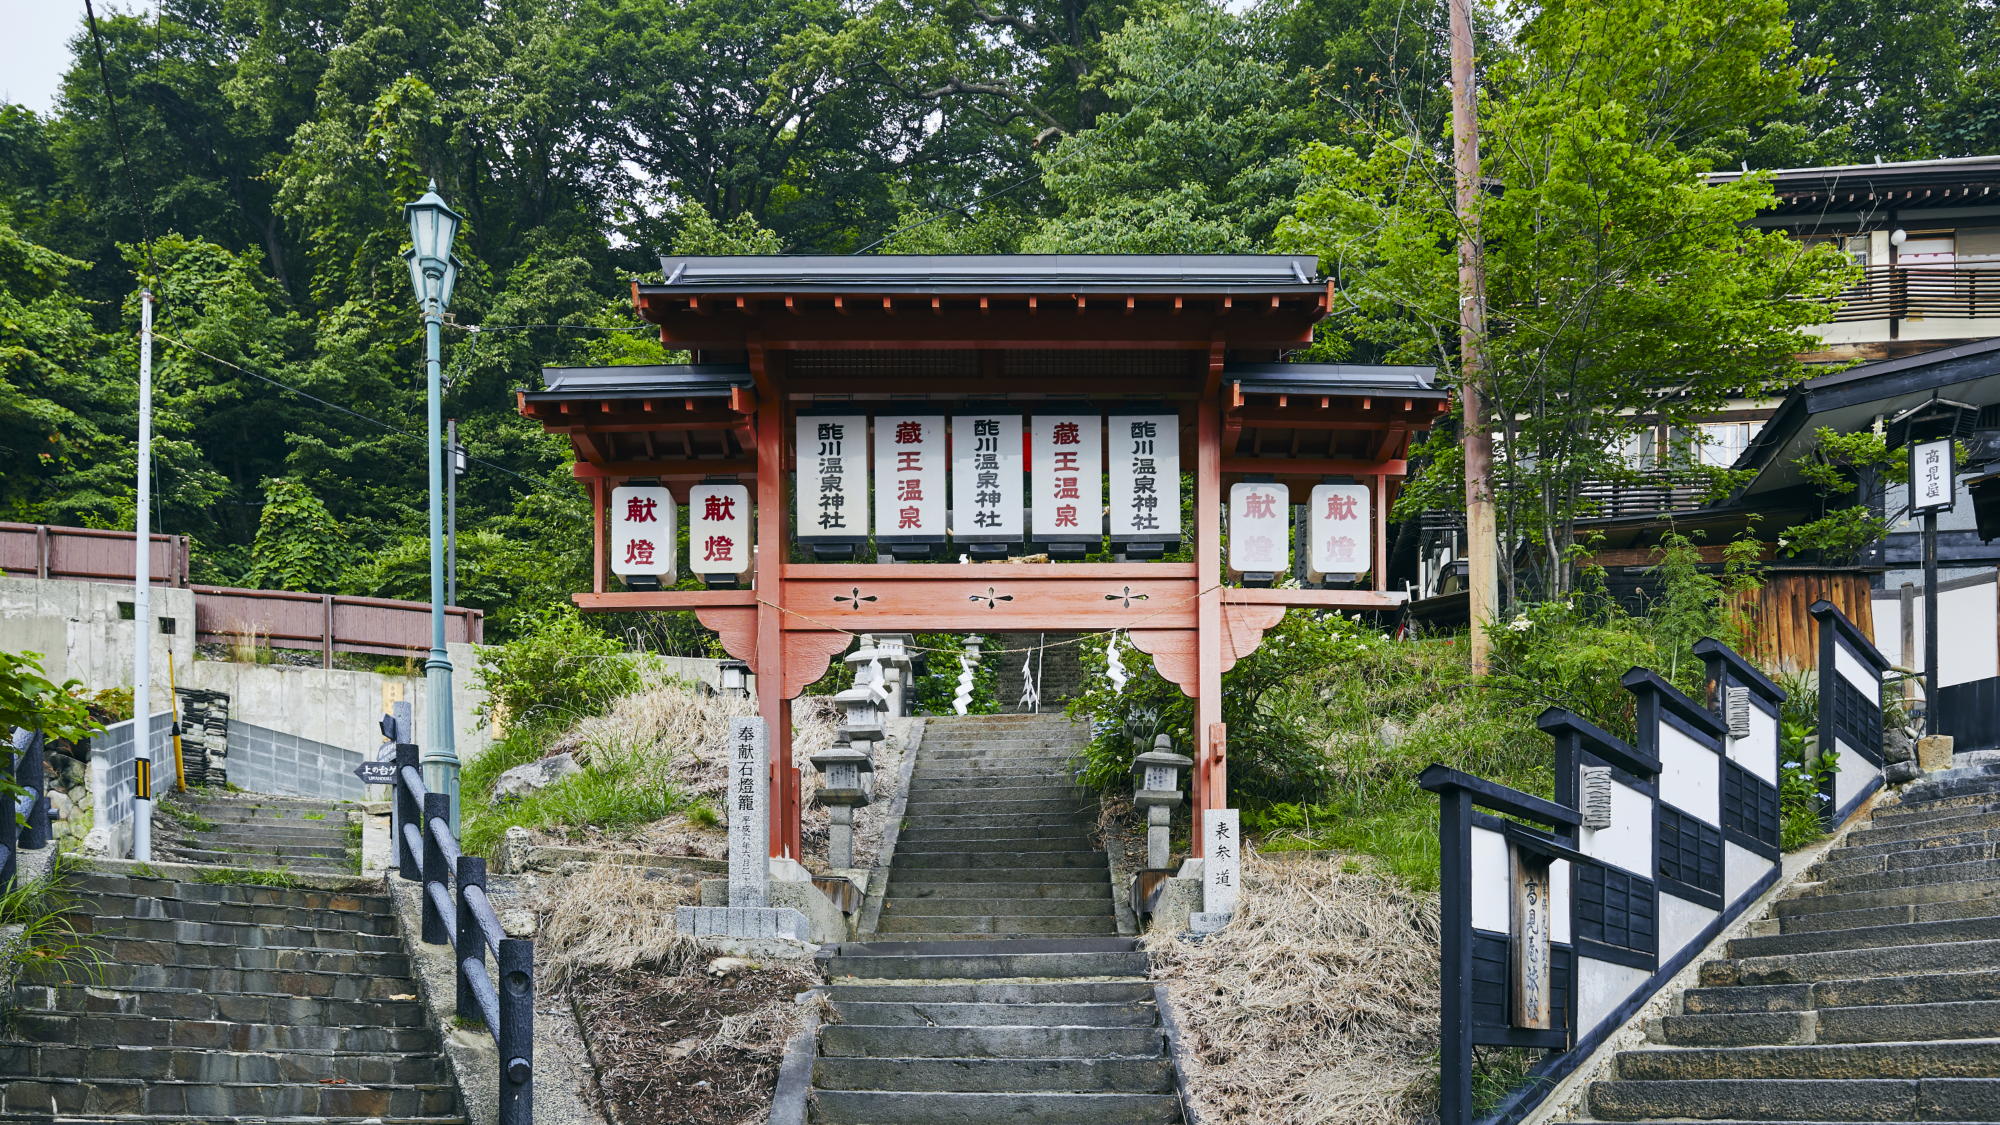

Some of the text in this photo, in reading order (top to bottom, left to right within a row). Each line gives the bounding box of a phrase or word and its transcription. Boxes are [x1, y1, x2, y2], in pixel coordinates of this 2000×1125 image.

[818, 423, 847, 530] 酢川温泉神社
[895, 421, 924, 529] 蔵王温泉
[973, 419, 1003, 528] 酢川温泉神社
[1052, 422, 1081, 528] 蔵王温泉
[1131, 421, 1160, 530] 酢川温泉神社
[1925, 449, 1939, 497] 高見屋
[625, 496, 658, 565] 献燈
[702, 495, 736, 562] 献燈
[1216, 822, 1231, 886] 表参道
